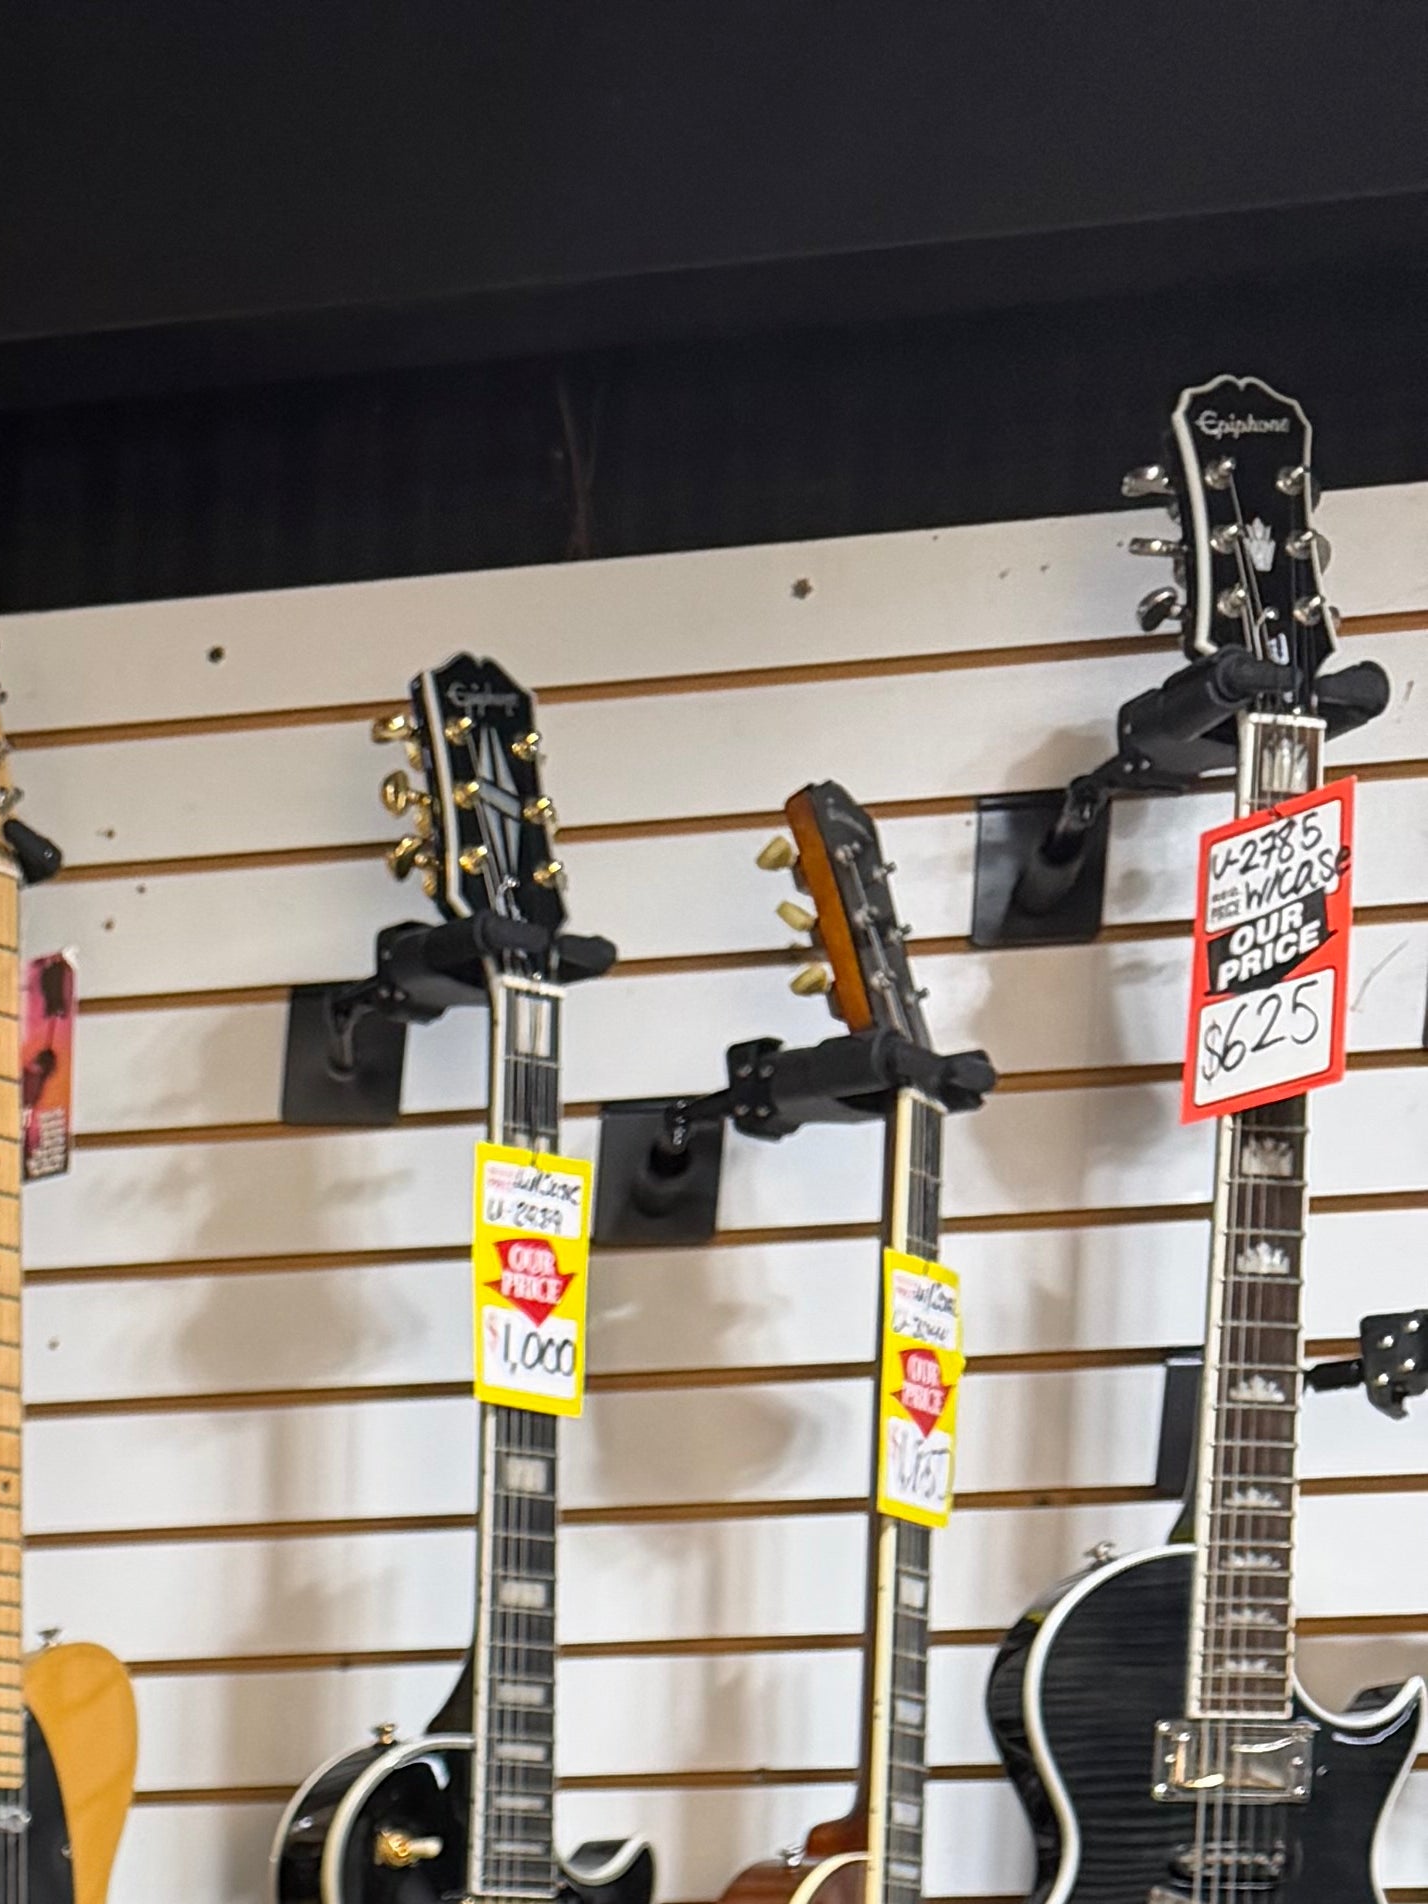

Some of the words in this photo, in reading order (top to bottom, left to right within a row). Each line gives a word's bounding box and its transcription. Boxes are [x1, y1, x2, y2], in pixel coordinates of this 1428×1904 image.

[1196, 409, 1291, 441] Epiphone
[1210, 811, 1323, 881] U-2785
[1229, 901, 1304, 957] OUR
[1217, 919, 1322, 992] PRICE
[1201, 980, 1320, 1083] $625
[507, 1243, 556, 1277] OUR
[500, 1269, 563, 1305] PRICE
[907, 1352, 942, 1387] OUR
[901, 1380, 945, 1416] PRICE
